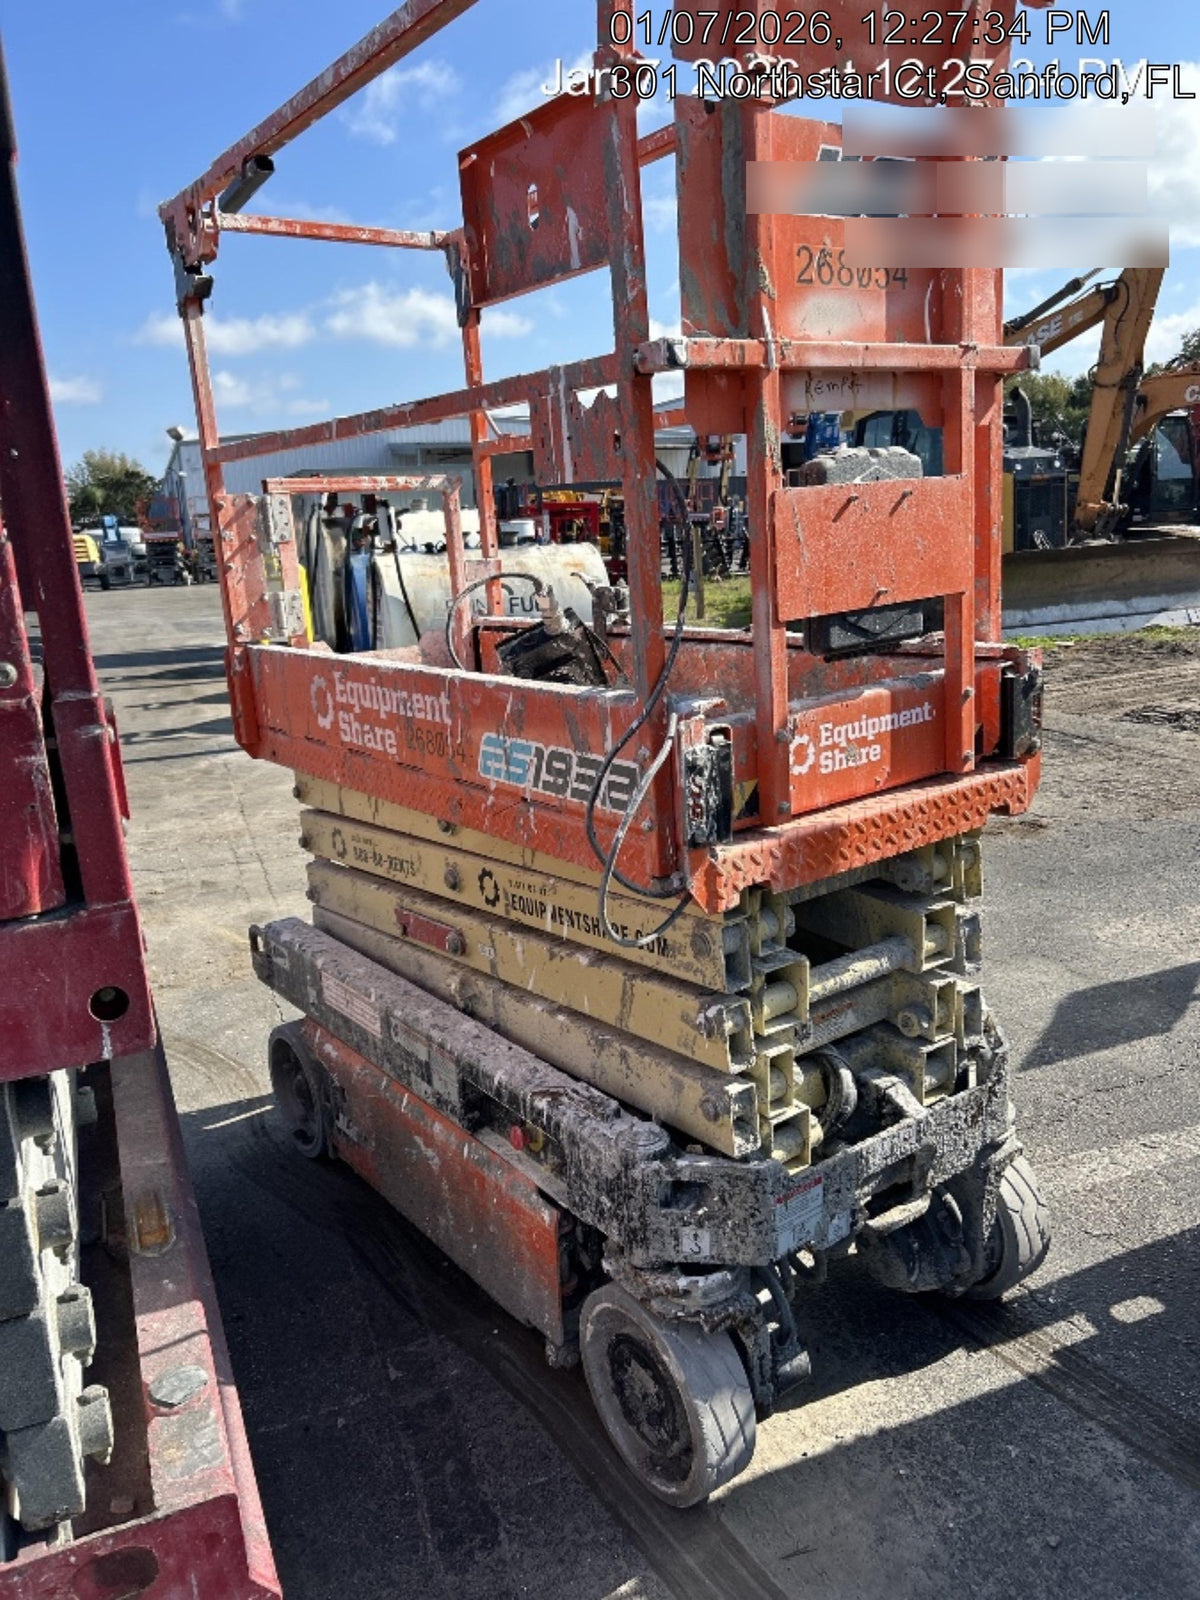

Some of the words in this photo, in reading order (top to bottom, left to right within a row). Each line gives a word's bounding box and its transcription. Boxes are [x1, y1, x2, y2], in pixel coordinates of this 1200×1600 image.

[333, 671, 453, 726] Equipment
[337, 710, 398, 755] Share
[819, 701, 933, 748] Equipment
[819, 743, 882, 775] Share
